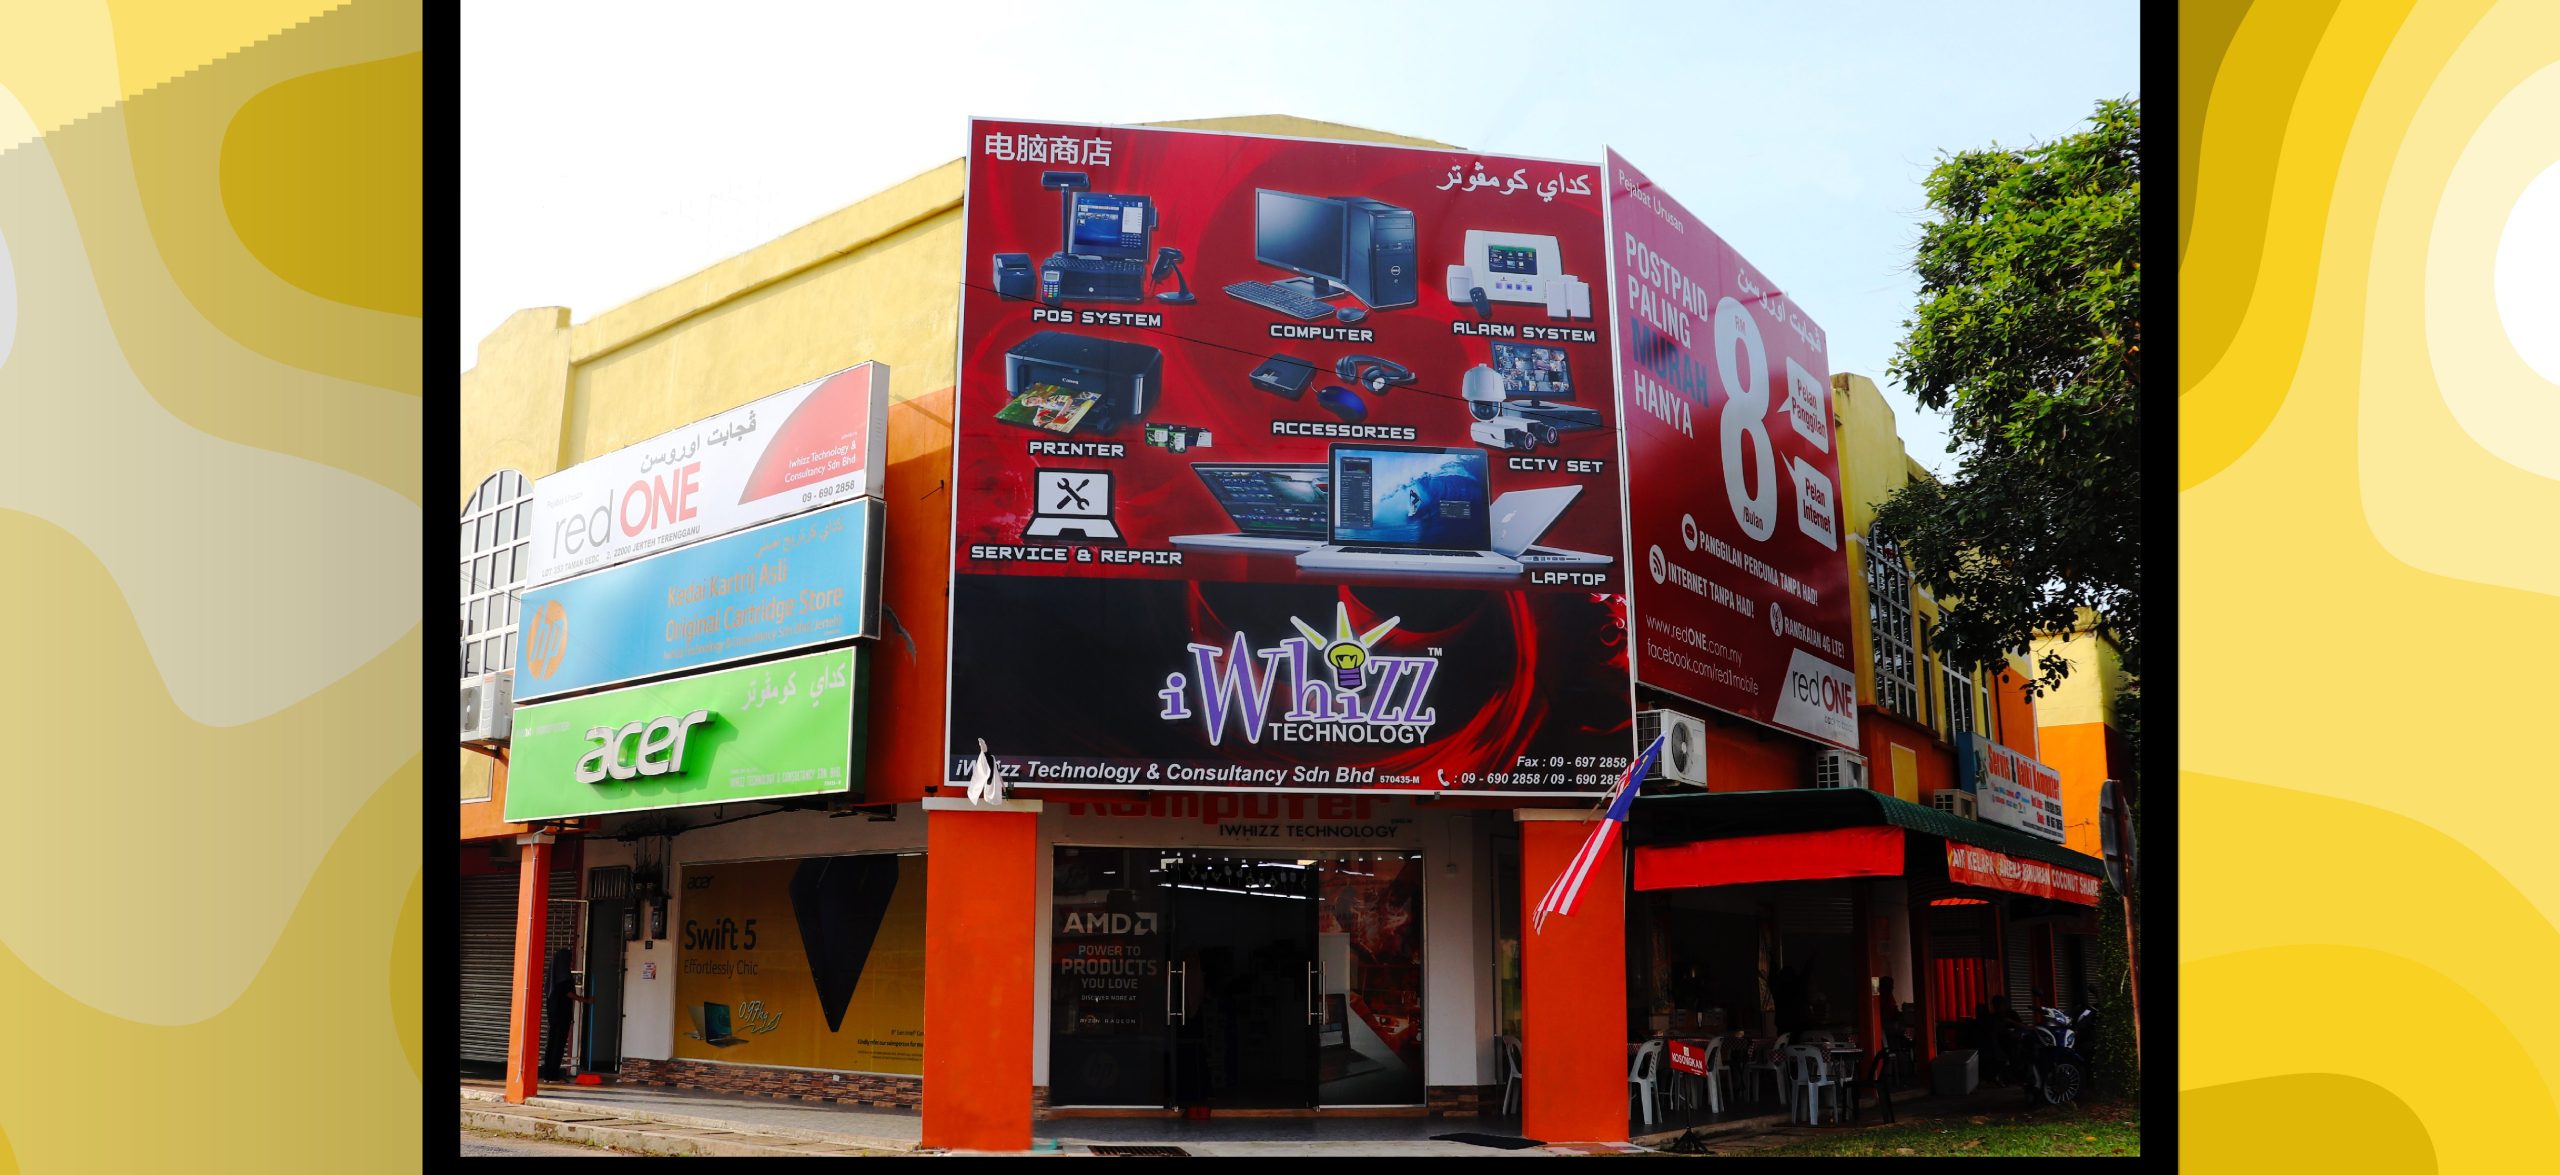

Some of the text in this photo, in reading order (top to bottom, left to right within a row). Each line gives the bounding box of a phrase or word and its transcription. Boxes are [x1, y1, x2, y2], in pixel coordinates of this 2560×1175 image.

[985, 132, 1112, 167] 电脑商店
[1537, 172, 1591, 202] كداي
[1618, 169, 1684, 235] Pejabat Urusan
[1625, 231, 1708, 322] POSTPAID
[1033, 309, 1162, 328] POS SYSTEM
[1628, 274, 1691, 349] PALING
[1270, 325, 1373, 342] COMPUTER
[1453, 322, 1596, 342] ALARM SYSTEM
[1735, 315, 1747, 338] RM
[1631, 314, 1710, 408] MURAH
[1634, 370, 1694, 439] HANYA
[1797, 379, 1818, 410] Pelan
[1715, 296, 1777, 542] 8
[1792, 396, 1827, 439] Panggilan
[1273, 422, 1416, 440] ACCESSORIES
[811, 444, 849, 461] Technology
[850, 440, 857, 450] &
[1029, 441, 1124, 457] PRINTER
[785, 455, 856, 483] Consultancy Sdn Bhd
[1509, 457, 1603, 474] CCTV SET
[802, 492, 812, 503] 09
[818, 486, 833, 499] 690
[835, 480, 855, 494] 2858
[1805, 477, 1826, 508] Pelan
[1803, 500, 1832, 535] Internet
[564, 559, 584, 572] TAMAN
[614, 543, 632, 558] 22000
[657, 525, 701, 546] TERENGGANU
[971, 545, 1182, 566] SERVICE & REPAIR
[1531, 571, 1606, 586] LAPTOP
[1700, 531, 1818, 606] PANGGILAN PERCUMA TANPA HAD!
[668, 558, 788, 608] Kedai Kartrij Asli
[1668, 562, 1755, 619] INTERNET TANPA HAD!
[666, 587, 844, 643] Original Cartridge Store
[1646, 614, 1743, 668] www.redONE.com.my
[1784, 616, 1822, 647] RANGKAIAN
[1822, 632, 1832, 652] 4G
[1268, 722, 1430, 744] TECHNOLOGY
[575, 709, 709, 785] acer
[956, 759, 1420, 785] iWzz Technology & Consultancy Sdn Bhd 570435-M
[1517, 756, 1538, 768] Fax
[1550, 756, 1564, 768] 09
[1575, 756, 1595, 768] 697
[1599, 756, 1627, 768] 2858
[1461, 773, 1475, 785] 09
[1486, 773, 1508, 785] 690
[1512, 773, 1541, 785] 2858
[1550, 773, 1565, 785] 09
[1575, 773, 1596, 785] 690
[1600, 773, 1620, 785] 285
[1220, 825, 1397, 838] IWHIZZ TECHNOLOGY
[687, 875, 715, 889] acer
[2051, 868, 2079, 893] COCONUT
[684, 917, 757, 951] Swift 5
[1063, 912, 1132, 934] AMD
[1078, 945, 1141, 956] POWER TO
[684, 959, 759, 979] Effortlessly Chic
[1061, 958, 1158, 976] PRODUCTS
[1081, 978, 1139, 990] YOU LOVE
